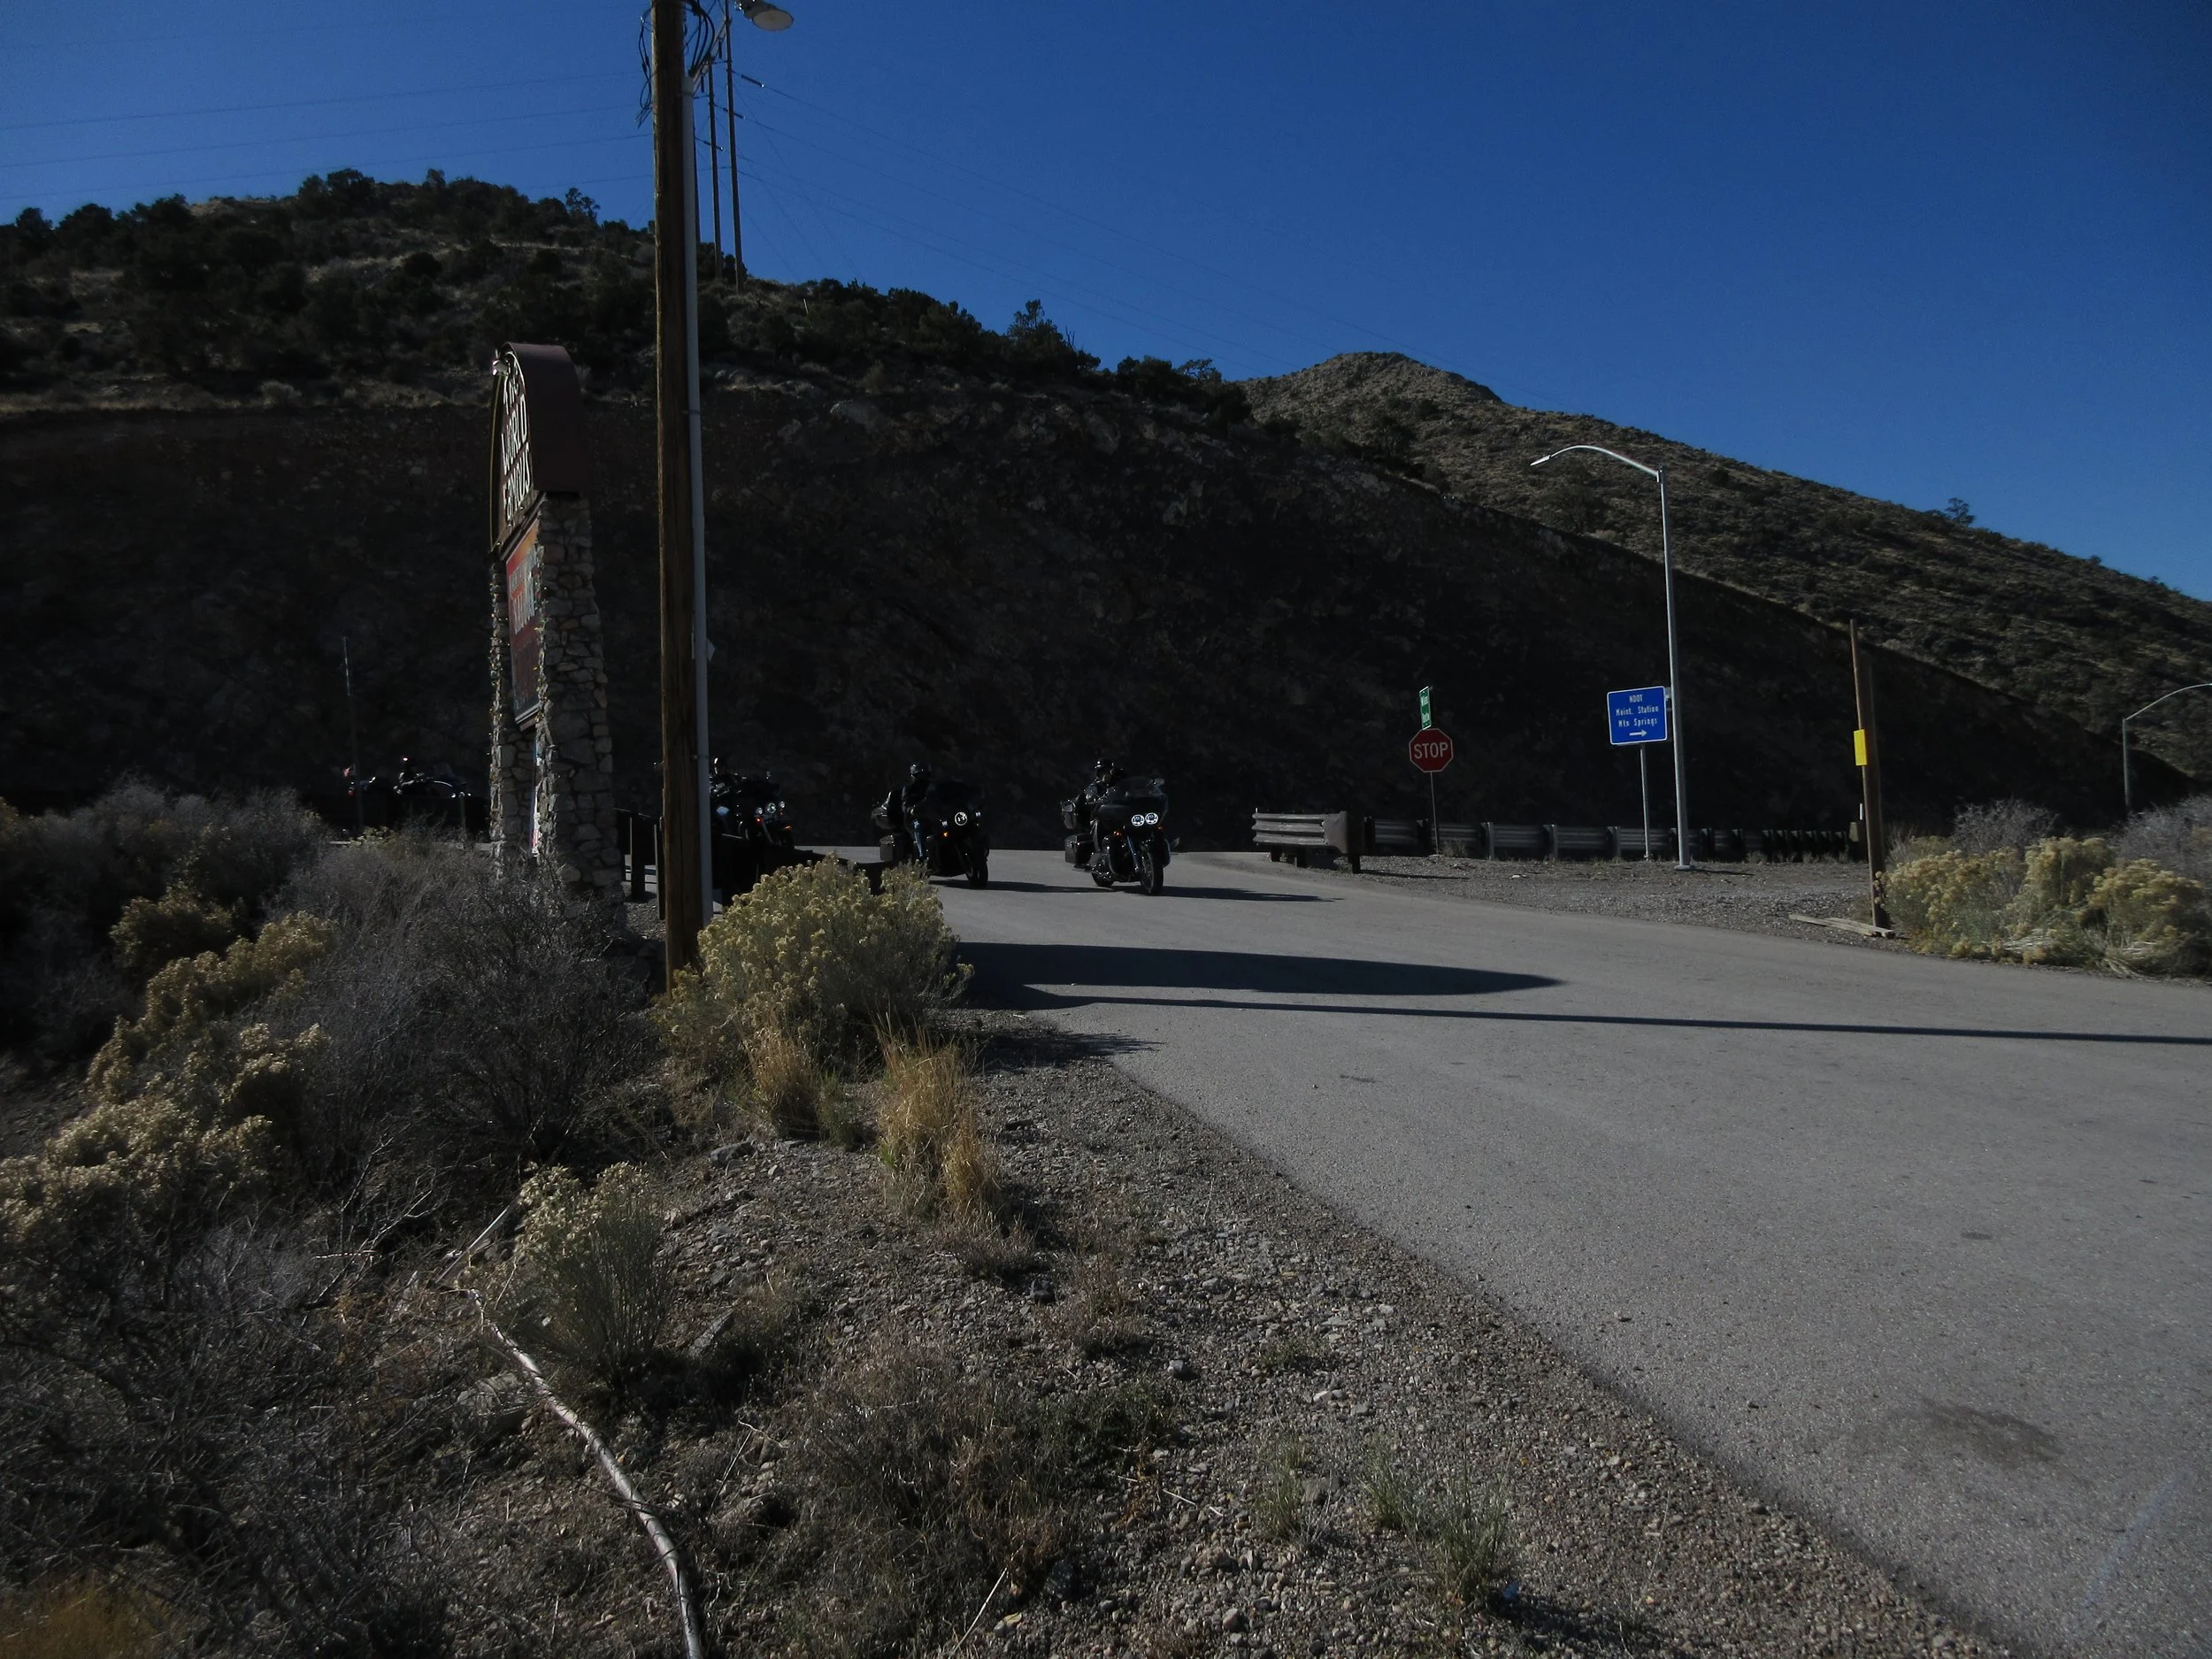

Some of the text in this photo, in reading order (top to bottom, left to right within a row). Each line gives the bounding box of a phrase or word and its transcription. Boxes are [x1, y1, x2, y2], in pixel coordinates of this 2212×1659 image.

[501, 393, 527, 475] WORLD
[1629, 694, 1643, 703] NDOT
[1637, 704, 1659, 714] Station
[1633, 718, 1657, 727] Springs
[1414, 741, 1448, 759] STOP
